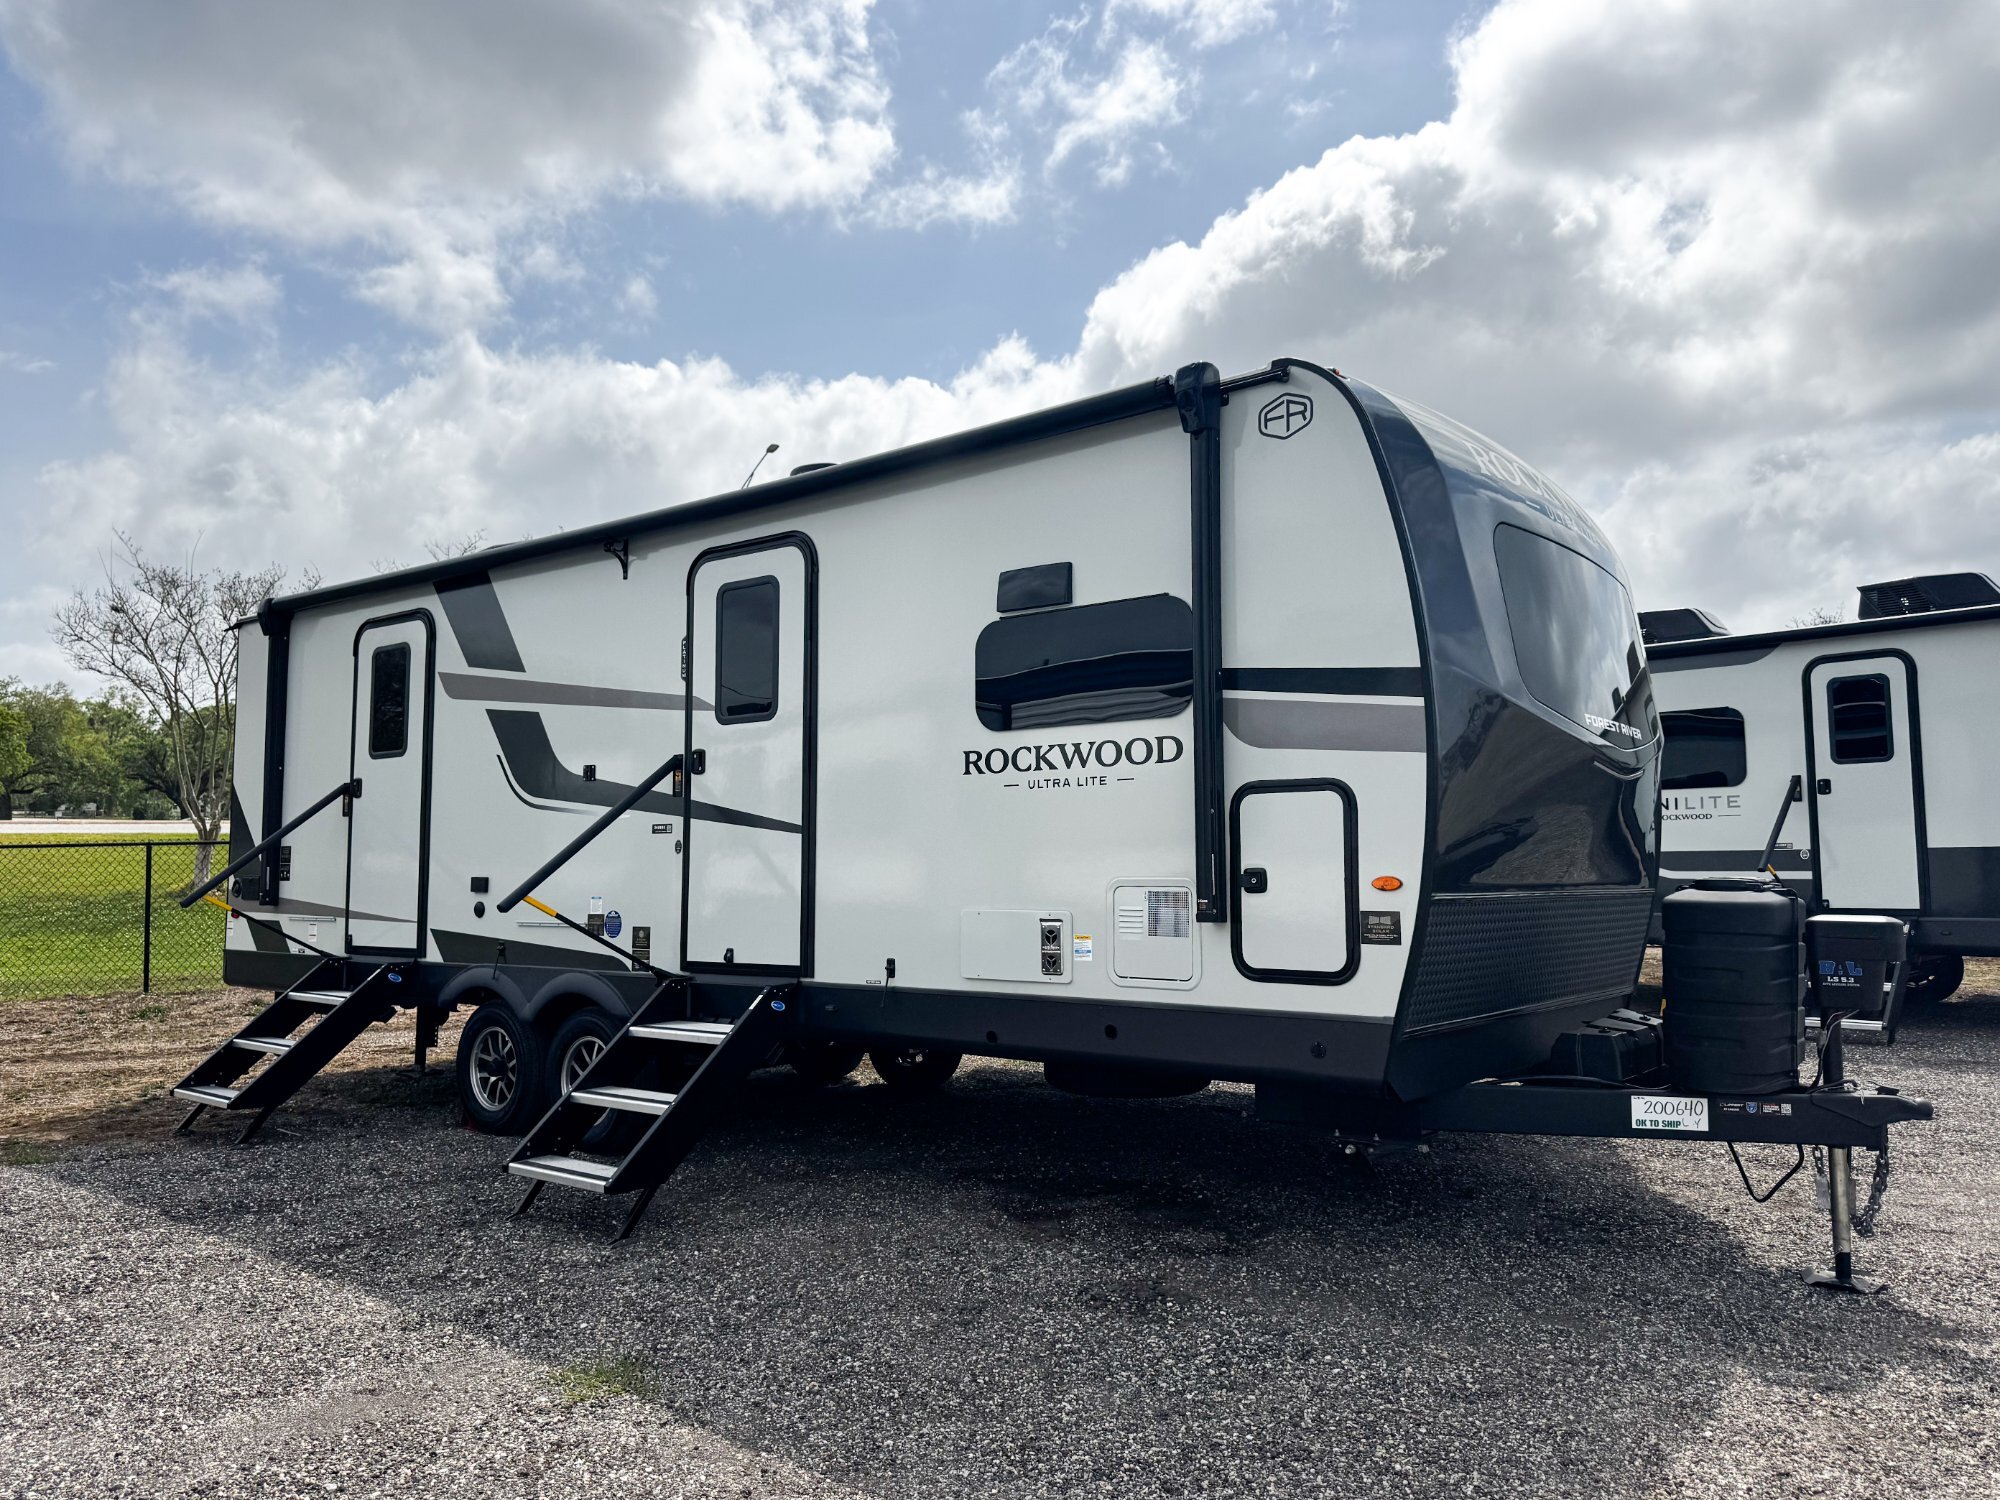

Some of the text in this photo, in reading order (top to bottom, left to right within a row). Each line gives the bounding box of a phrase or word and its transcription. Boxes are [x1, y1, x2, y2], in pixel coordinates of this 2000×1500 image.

[1584, 713, 1643, 740] FOREST RIVER
[962, 735, 1184, 776] ROCKWOOD
[1028, 776, 1108, 790] ULTRA LITE
[1661, 795, 1741, 811] NILITE
[1662, 813, 1713, 821] OCKWOOD
[1643, 1099, 1704, 1117] 200640
[1635, 1118, 1681, 1129] OK TO SHIP
